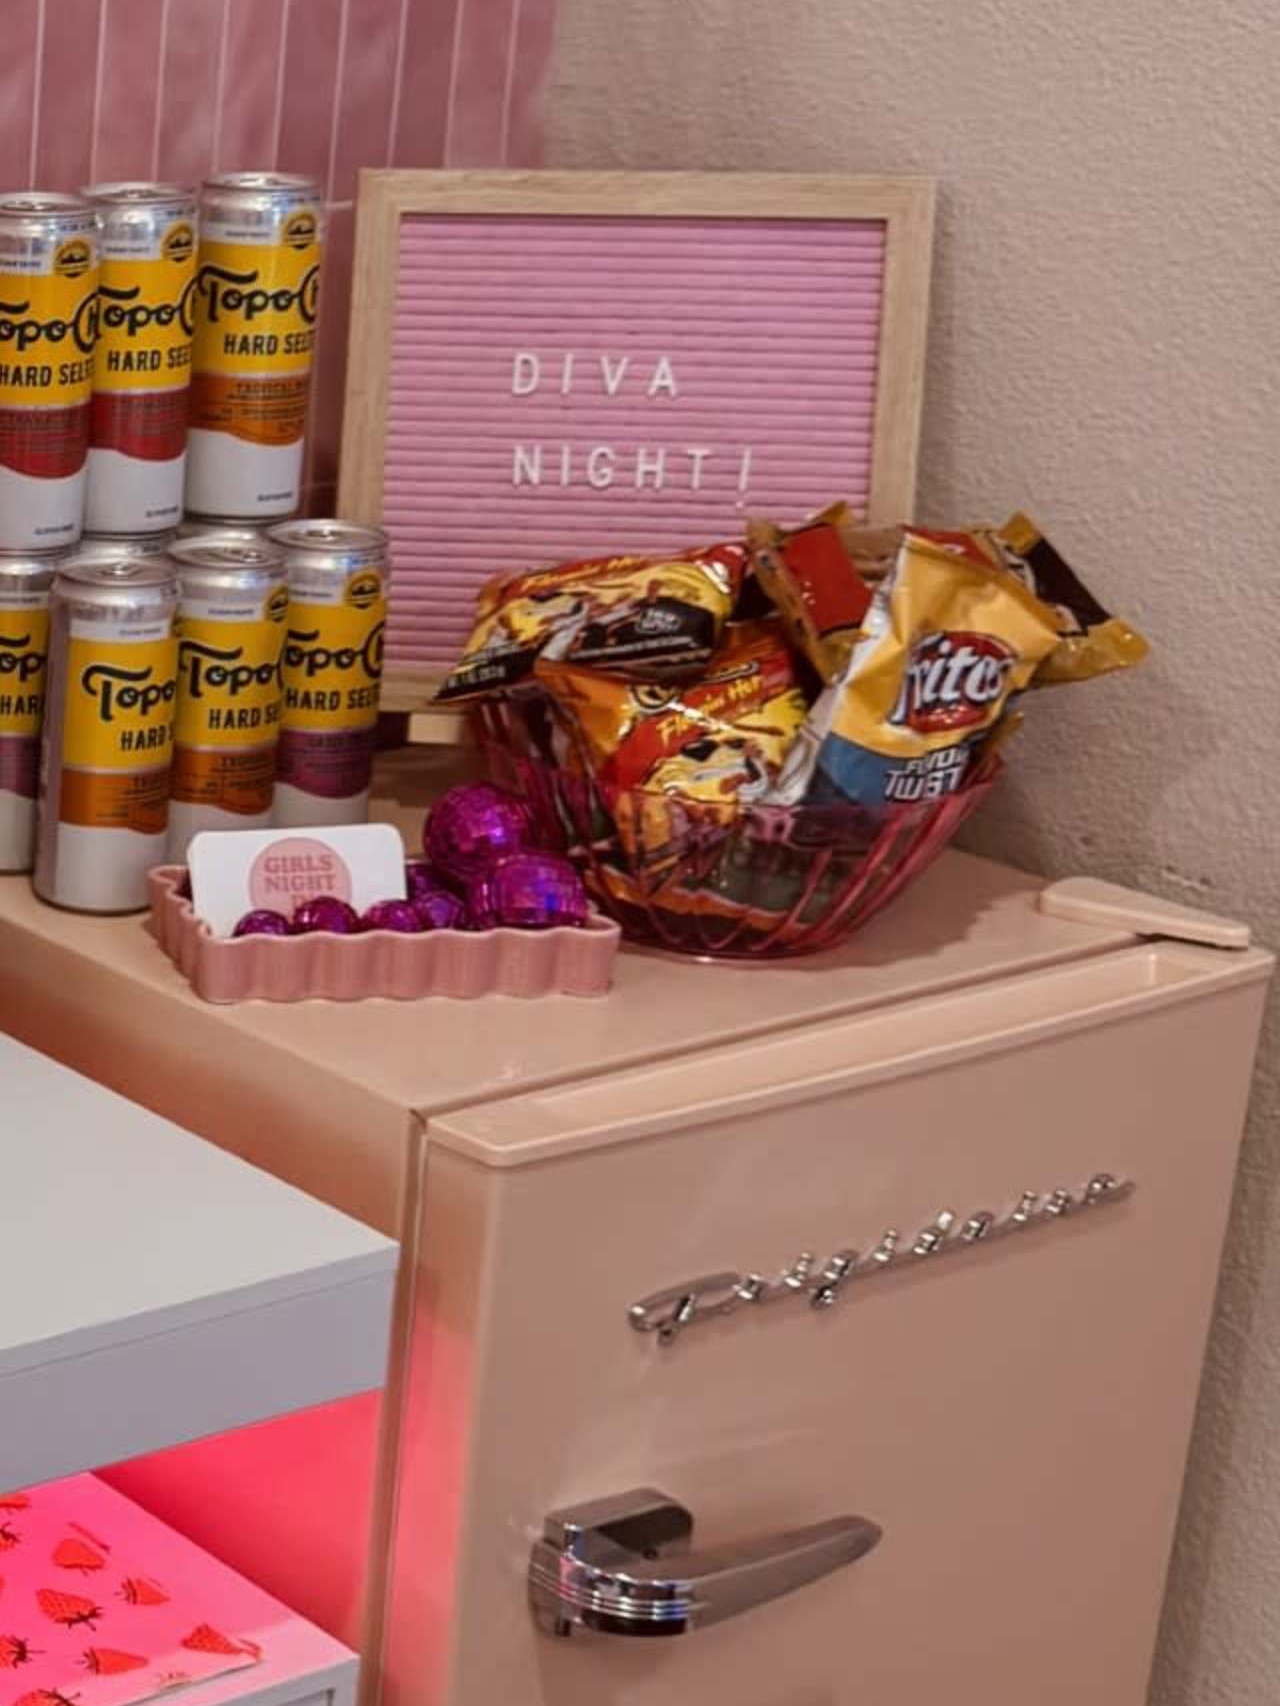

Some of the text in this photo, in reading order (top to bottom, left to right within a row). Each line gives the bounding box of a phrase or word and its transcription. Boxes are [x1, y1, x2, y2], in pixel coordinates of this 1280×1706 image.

[198, 264, 295, 323] Topo
[223, 333, 279, 357] HARD
[106, 349, 161, 372] HARD
[511, 351, 679, 396] DIVA
[178, 640, 274, 699] Topo
[208, 708, 261, 730] HARD
[121, 725, 167, 752] HARD
[263, 854, 333, 874] GIRLS
[264, 874, 337, 893] NIGHT
